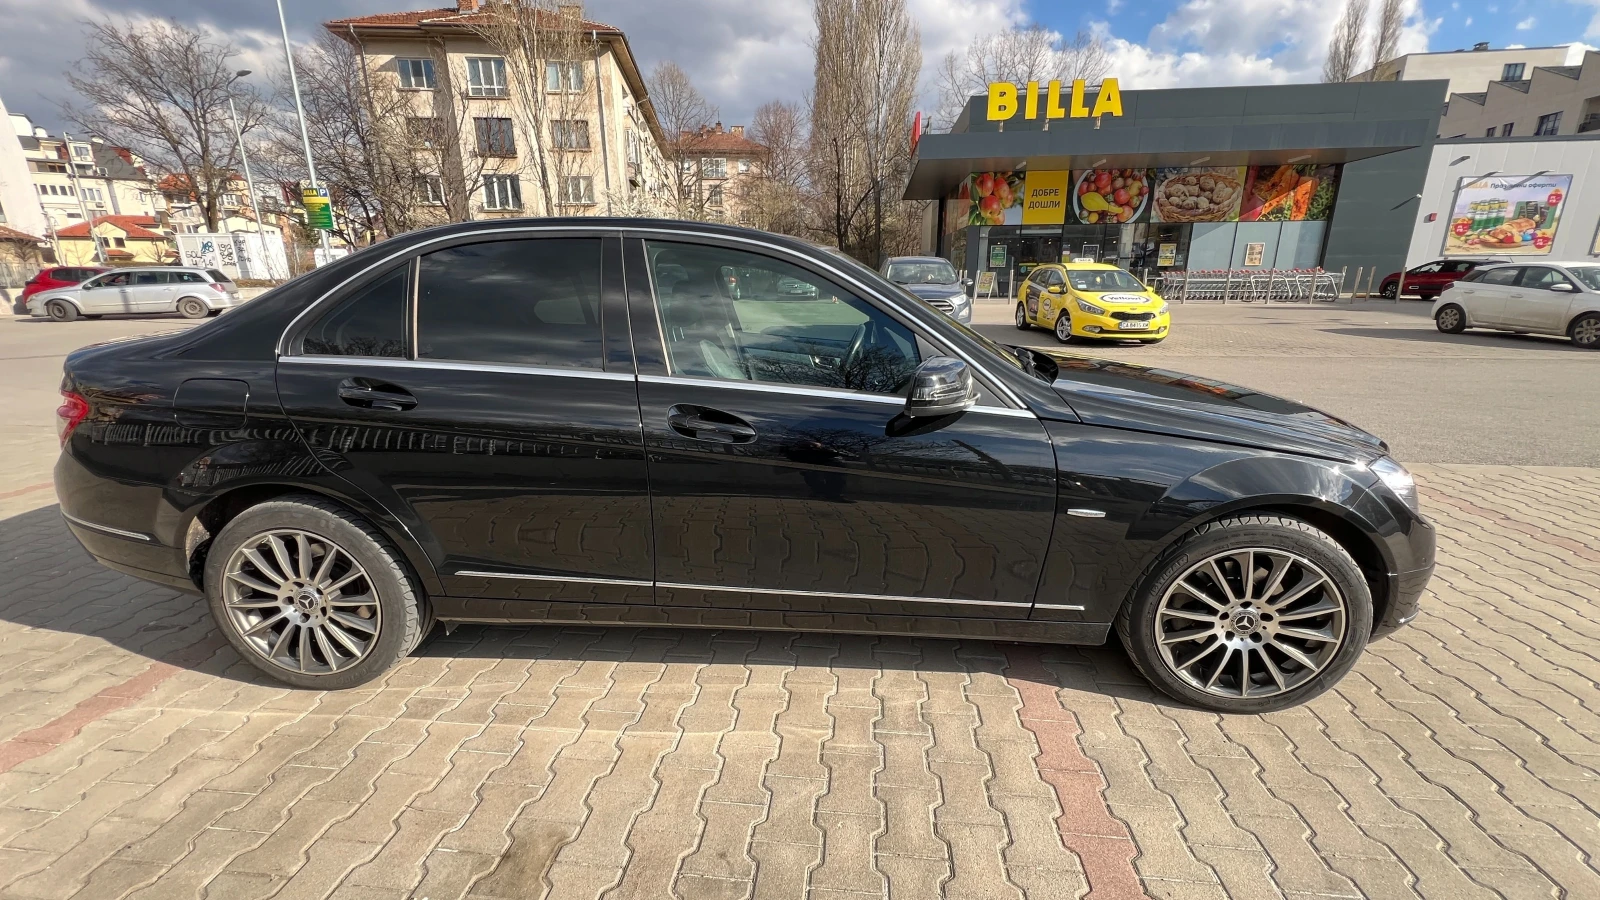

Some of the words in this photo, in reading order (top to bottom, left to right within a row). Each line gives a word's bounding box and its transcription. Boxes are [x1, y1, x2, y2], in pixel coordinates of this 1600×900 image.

[987, 77, 1123, 121] BILLA
[1031, 188, 1060, 198] ДОБРЕ
[1028, 200, 1061, 210] ДОШЛИ
